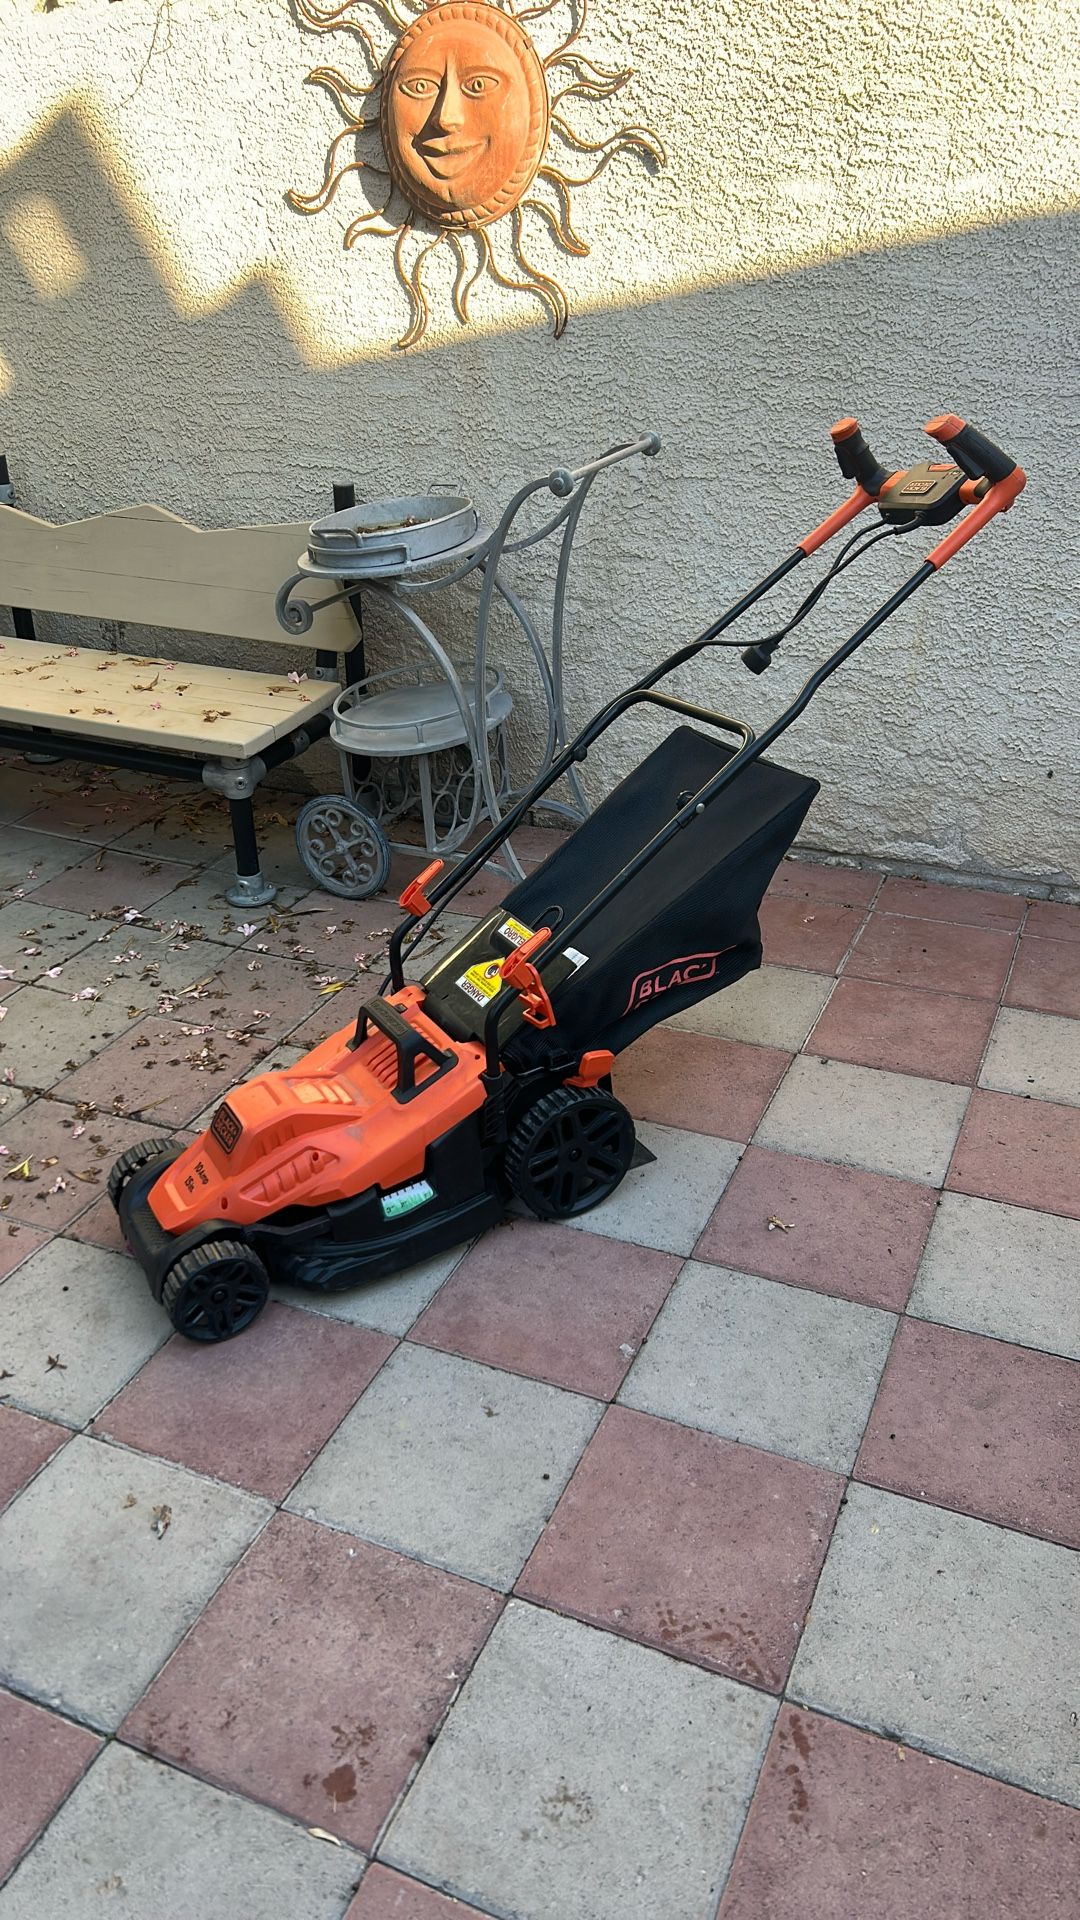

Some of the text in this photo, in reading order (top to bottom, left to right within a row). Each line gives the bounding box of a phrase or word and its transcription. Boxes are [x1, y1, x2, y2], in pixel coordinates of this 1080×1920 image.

[503, 927, 526, 945] ELIGRO
[461, 980, 485, 1002] DANGER
[638, 963, 708, 1000] BLAC
